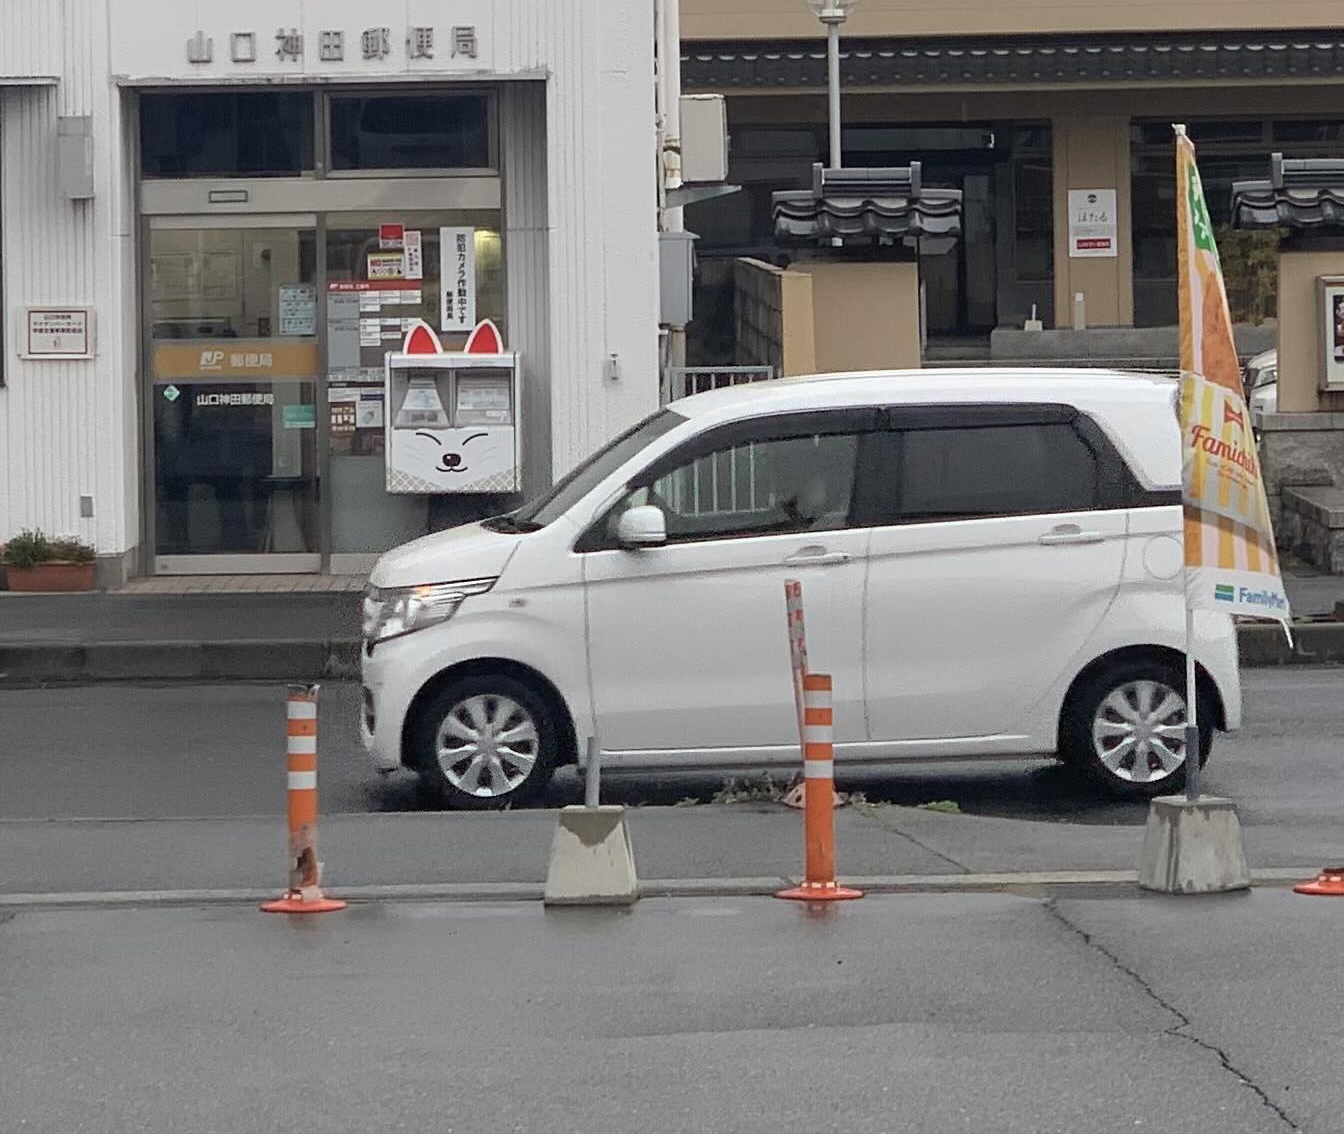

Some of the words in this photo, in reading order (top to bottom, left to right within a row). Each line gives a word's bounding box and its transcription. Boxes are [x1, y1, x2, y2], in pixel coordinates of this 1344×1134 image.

[186, 26, 478, 63] 山口神田郵便局
[456, 233, 468, 325] 防犯カメラ作動中です
[231, 352, 273, 367] 郵便局
[196, 392, 275, 406] 山口神田郵便局
